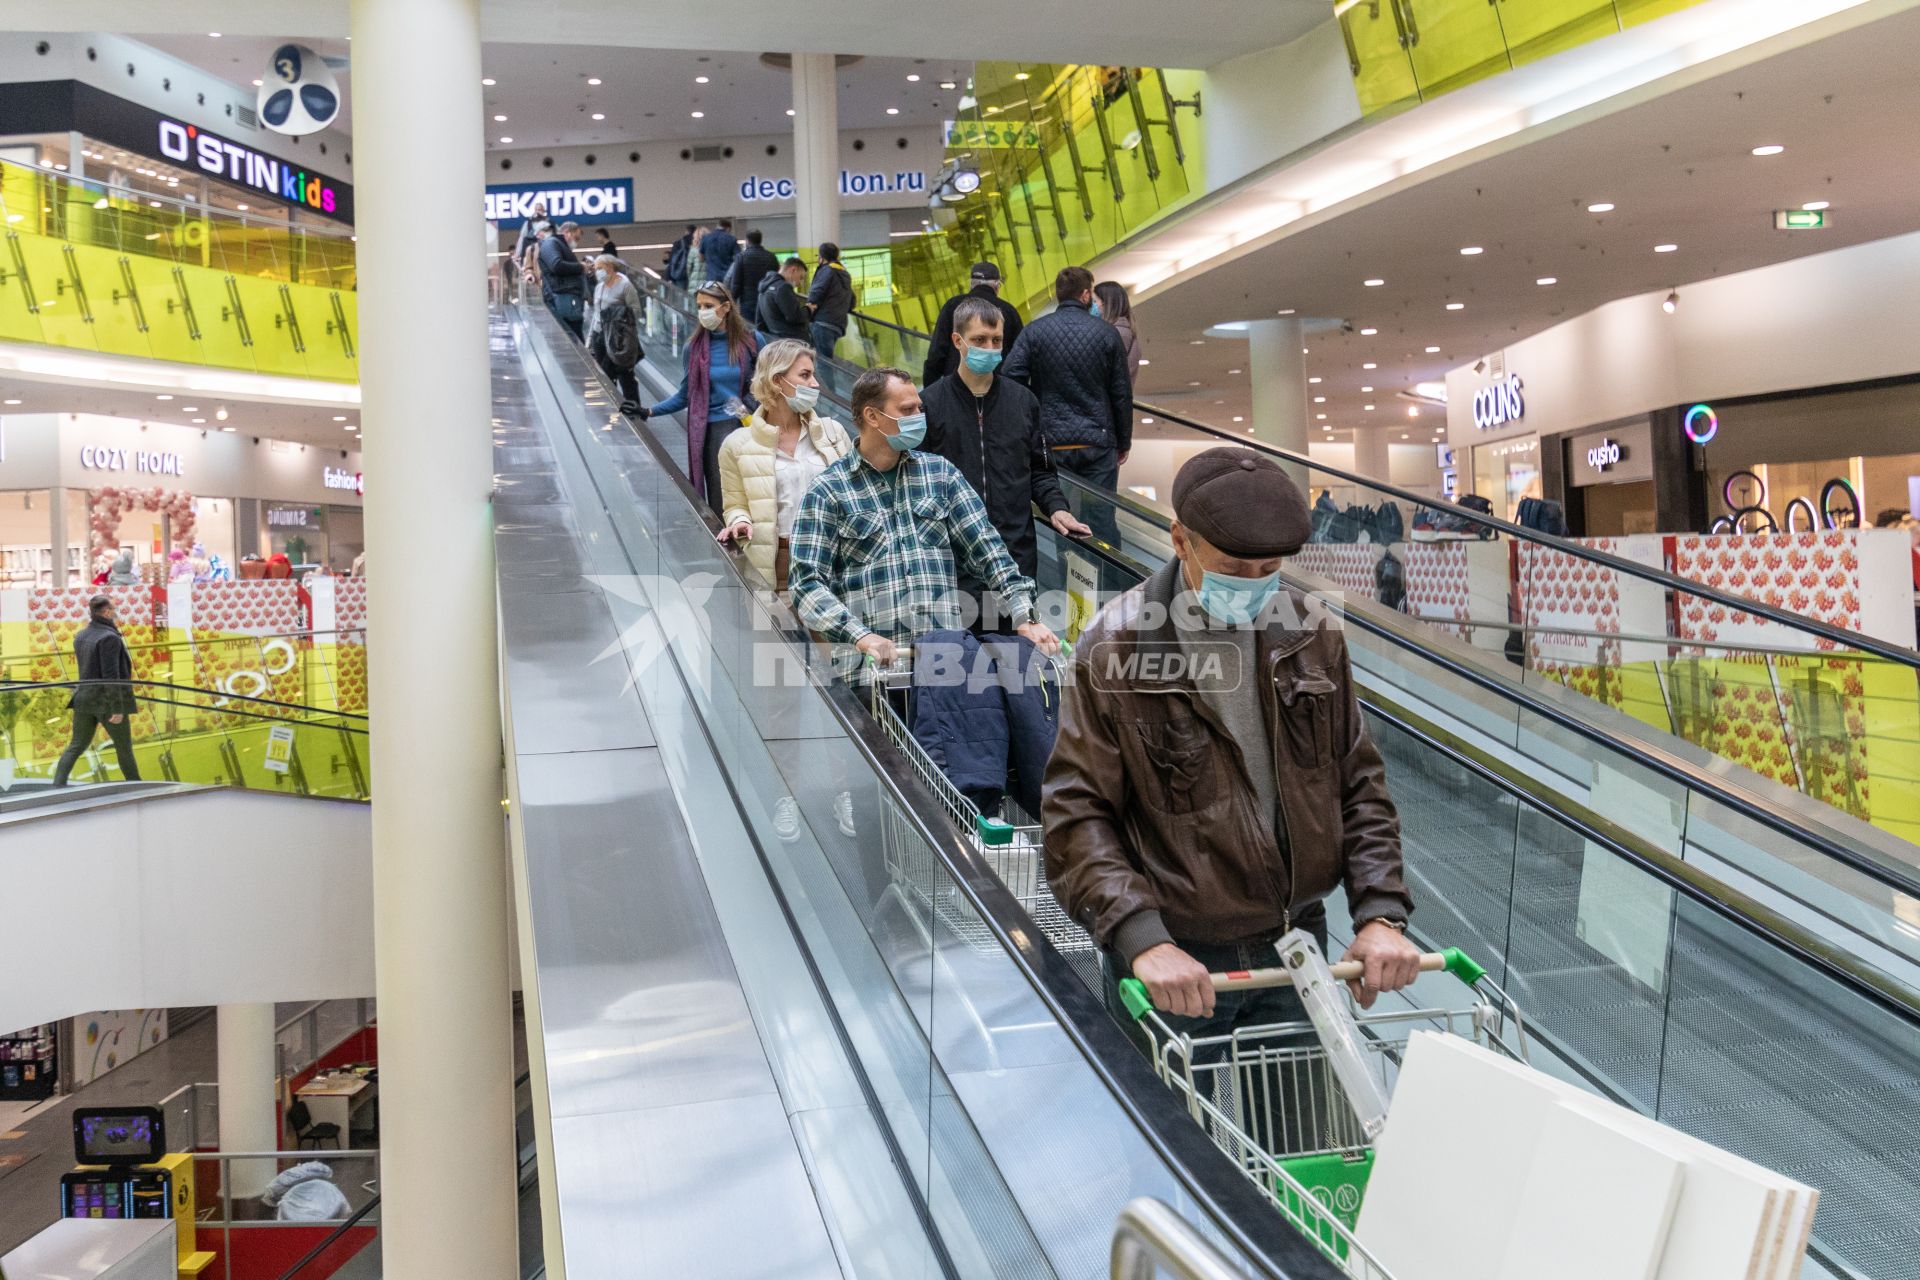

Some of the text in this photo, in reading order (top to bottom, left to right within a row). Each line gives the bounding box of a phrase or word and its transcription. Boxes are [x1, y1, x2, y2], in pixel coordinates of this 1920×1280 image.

[277, 59, 295, 82] 3
[159, 120, 337, 213] O'STIN kids
[81, 446, 184, 476] COZY HOME
[1588, 438, 1620, 472] oysho
[324, 466, 357, 490] fashion
